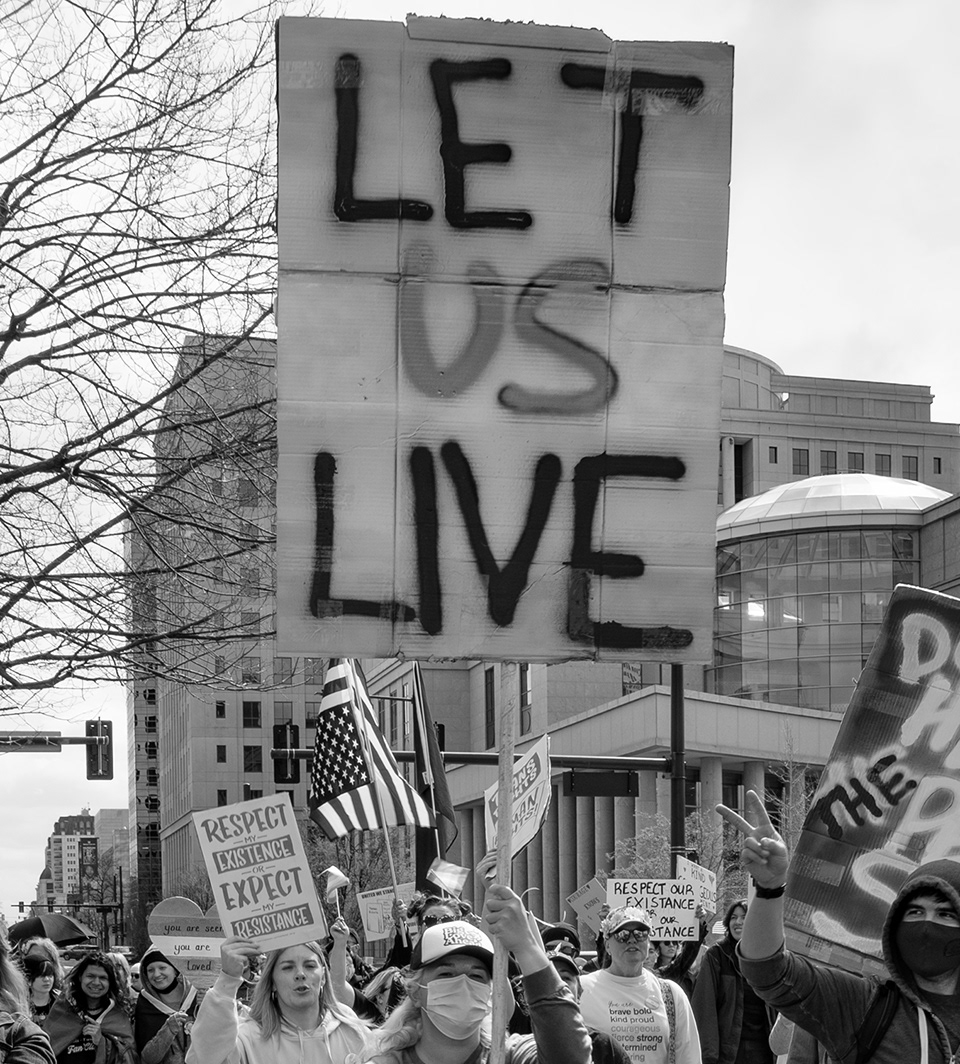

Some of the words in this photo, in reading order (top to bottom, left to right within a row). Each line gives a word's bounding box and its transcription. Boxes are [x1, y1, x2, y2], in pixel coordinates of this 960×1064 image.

[334, 53, 704, 229] LET
[398, 242, 619, 414] US
[311, 440, 694, 649] LIVE
[815, 754, 918, 840] THE
[201, 803, 288, 844] RESPECT
[244, 835, 258, 844] MY
[216, 837, 292, 872] EXISTENCE
[252, 865, 266, 874] OR
[219, 867, 303, 911] EXPECT
[614, 882, 666, 895] RESPECT
[671, 884, 694, 896] OUR
[262, 903, 276, 912] MY
[626, 897, 695, 910] EXISTANCE
[234, 906, 310, 938] RESISTANCE
[660, 916, 679, 925] OUR
[163, 925, 181, 936] you
[187, 925, 200, 933] are
[173, 944, 190, 955] you
[630, 1016, 655, 1024] proud
[611, 1026, 661, 1034] courageous
[636, 1034, 663, 1043] strong
